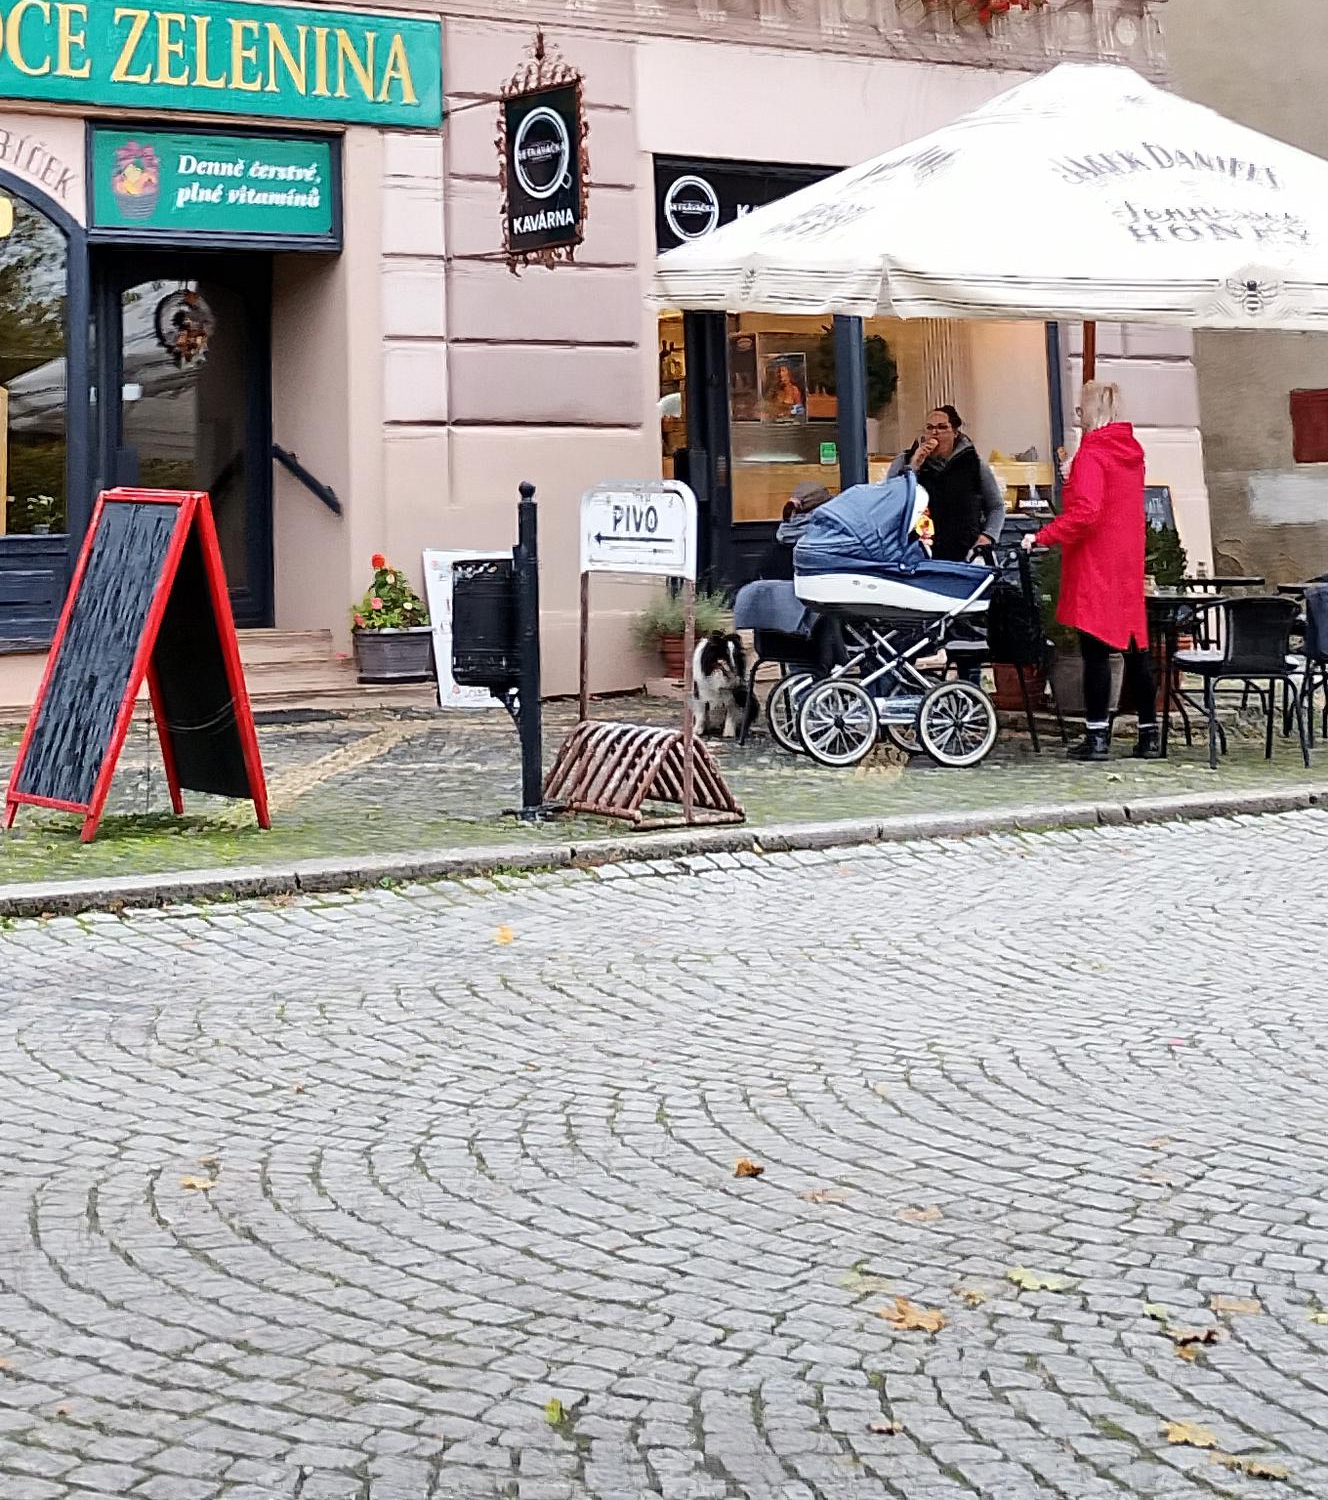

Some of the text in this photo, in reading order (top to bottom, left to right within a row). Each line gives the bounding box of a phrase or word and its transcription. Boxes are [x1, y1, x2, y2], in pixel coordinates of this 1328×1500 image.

[111, 6, 419, 106] ZELENINA
[178, 155, 245, 177] Denně
[176, 183, 321, 208] plné vitamínů
[513, 208, 575, 235] KAVÁRNA
[612, 504, 659, 533] PIVO
